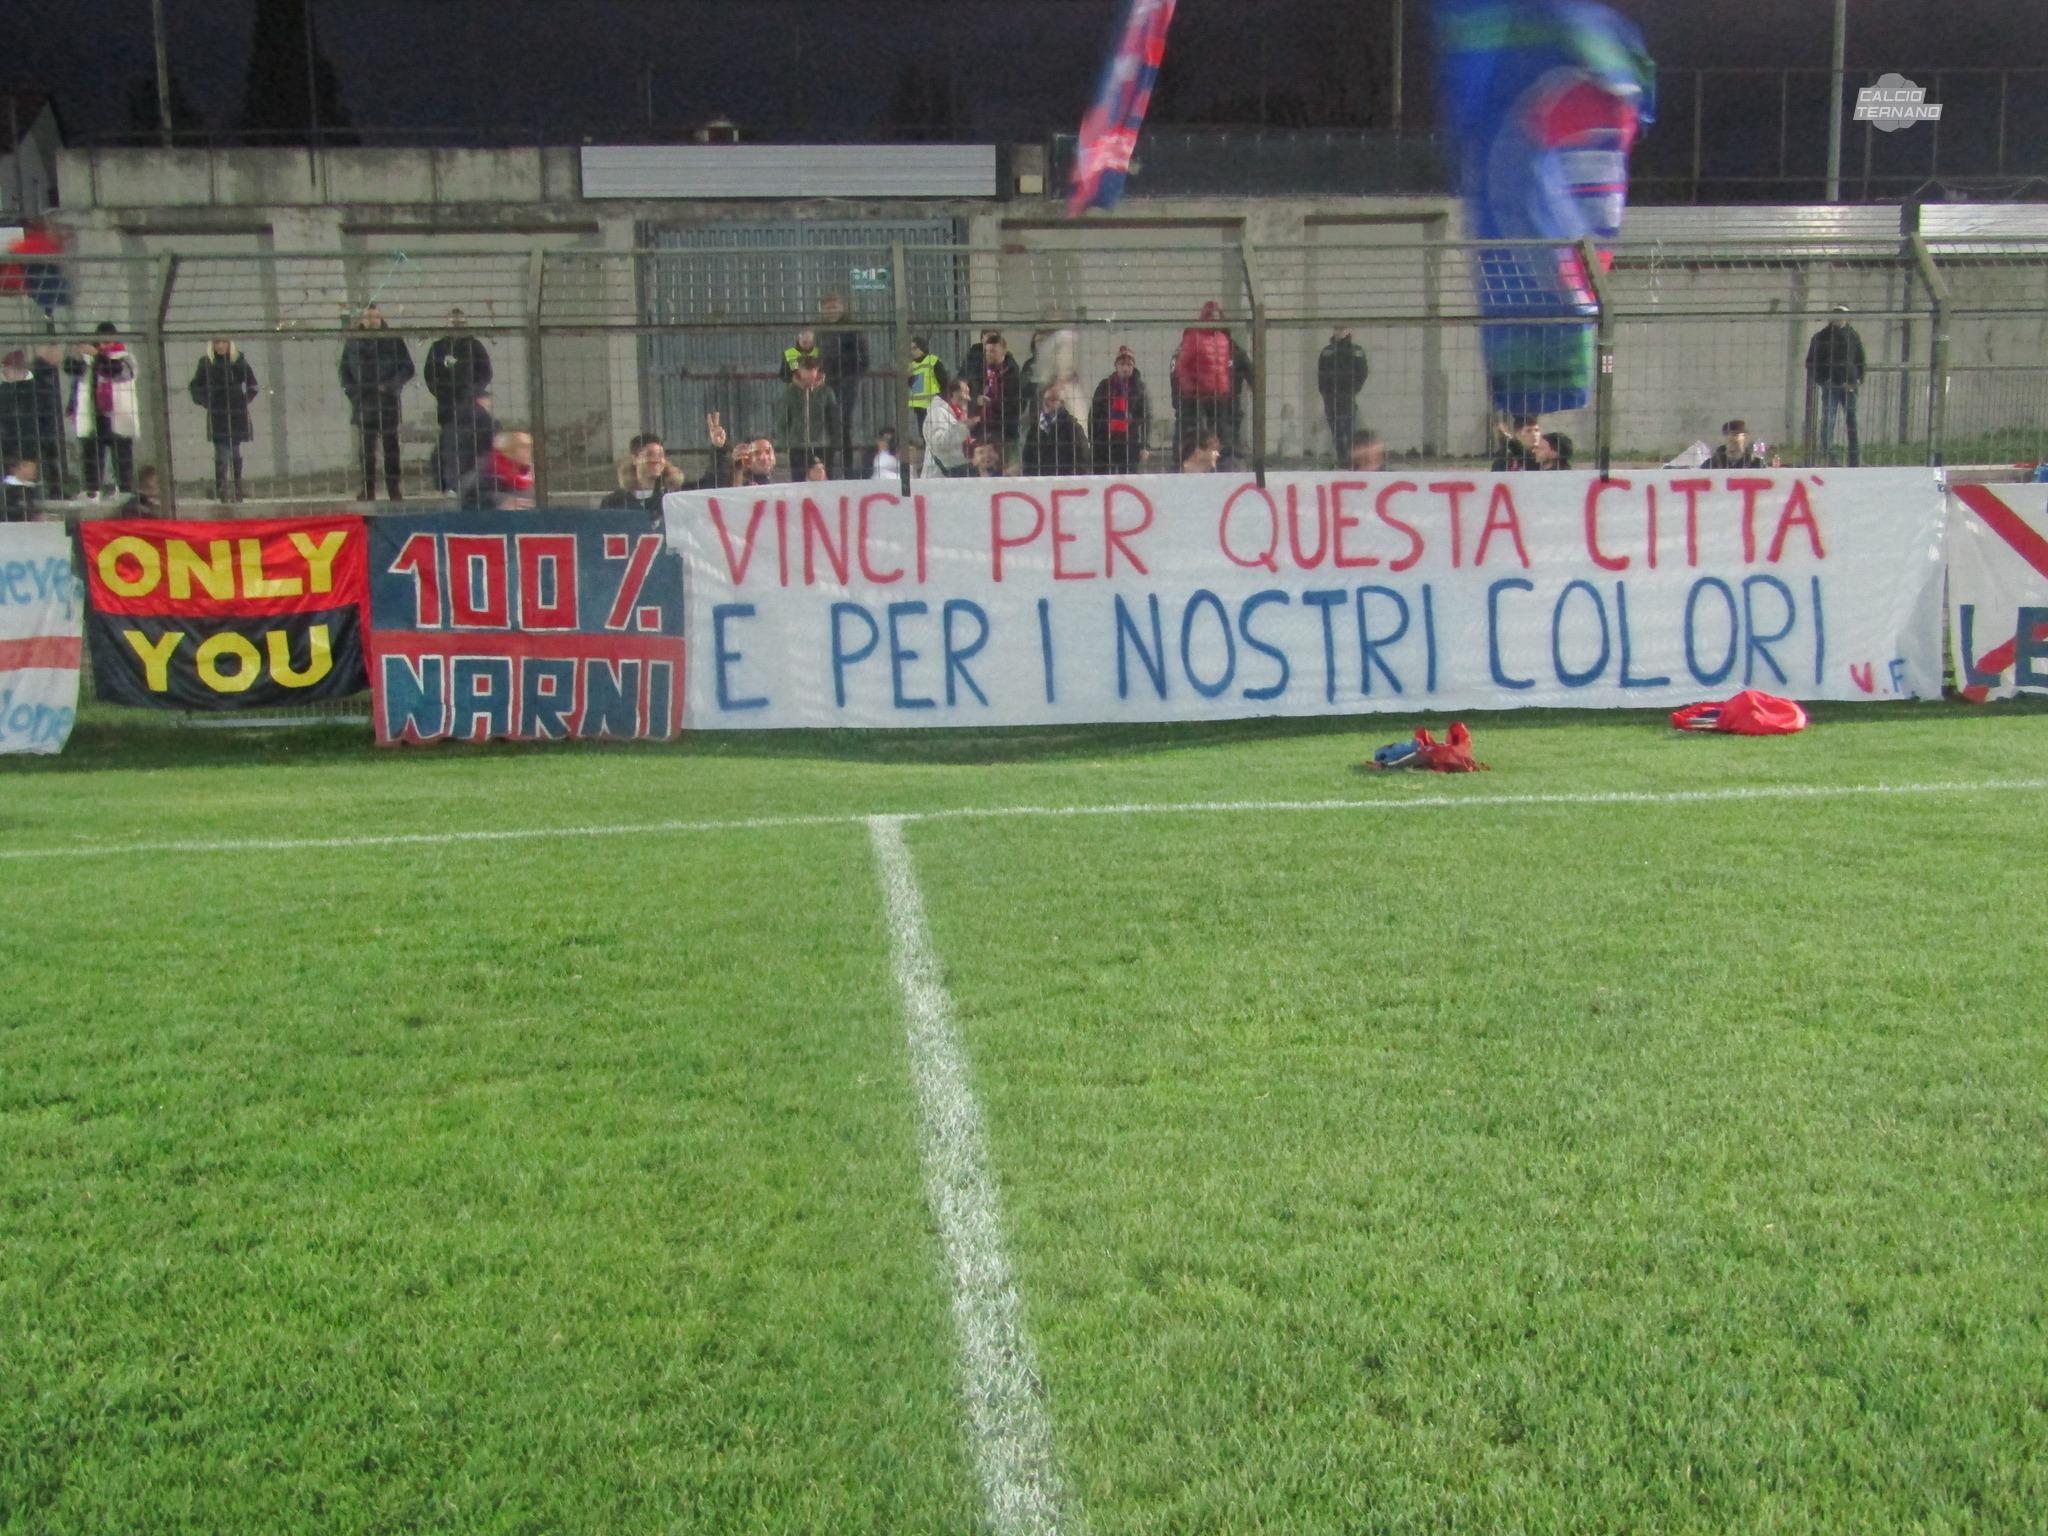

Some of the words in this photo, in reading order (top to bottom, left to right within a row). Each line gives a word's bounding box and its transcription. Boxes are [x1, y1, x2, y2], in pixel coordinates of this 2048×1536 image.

[98, 531, 349, 600] ONLY
[708, 492, 927, 588] VINCI
[990, 483, 1154, 584] PER
[1219, 481, 1530, 573] QUESTA
[1585, 476, 1826, 571] CITTÀ
[124, 624, 333, 693] YOU
[712, 603, 769, 711] E
[830, 598, 990, 708] PER
[1037, 597, 1056, 704] I
[1113, 583, 1437, 704] NOSTRI
[1487, 574, 1826, 689] COLORI
[380, 653, 674, 739] NARNI
